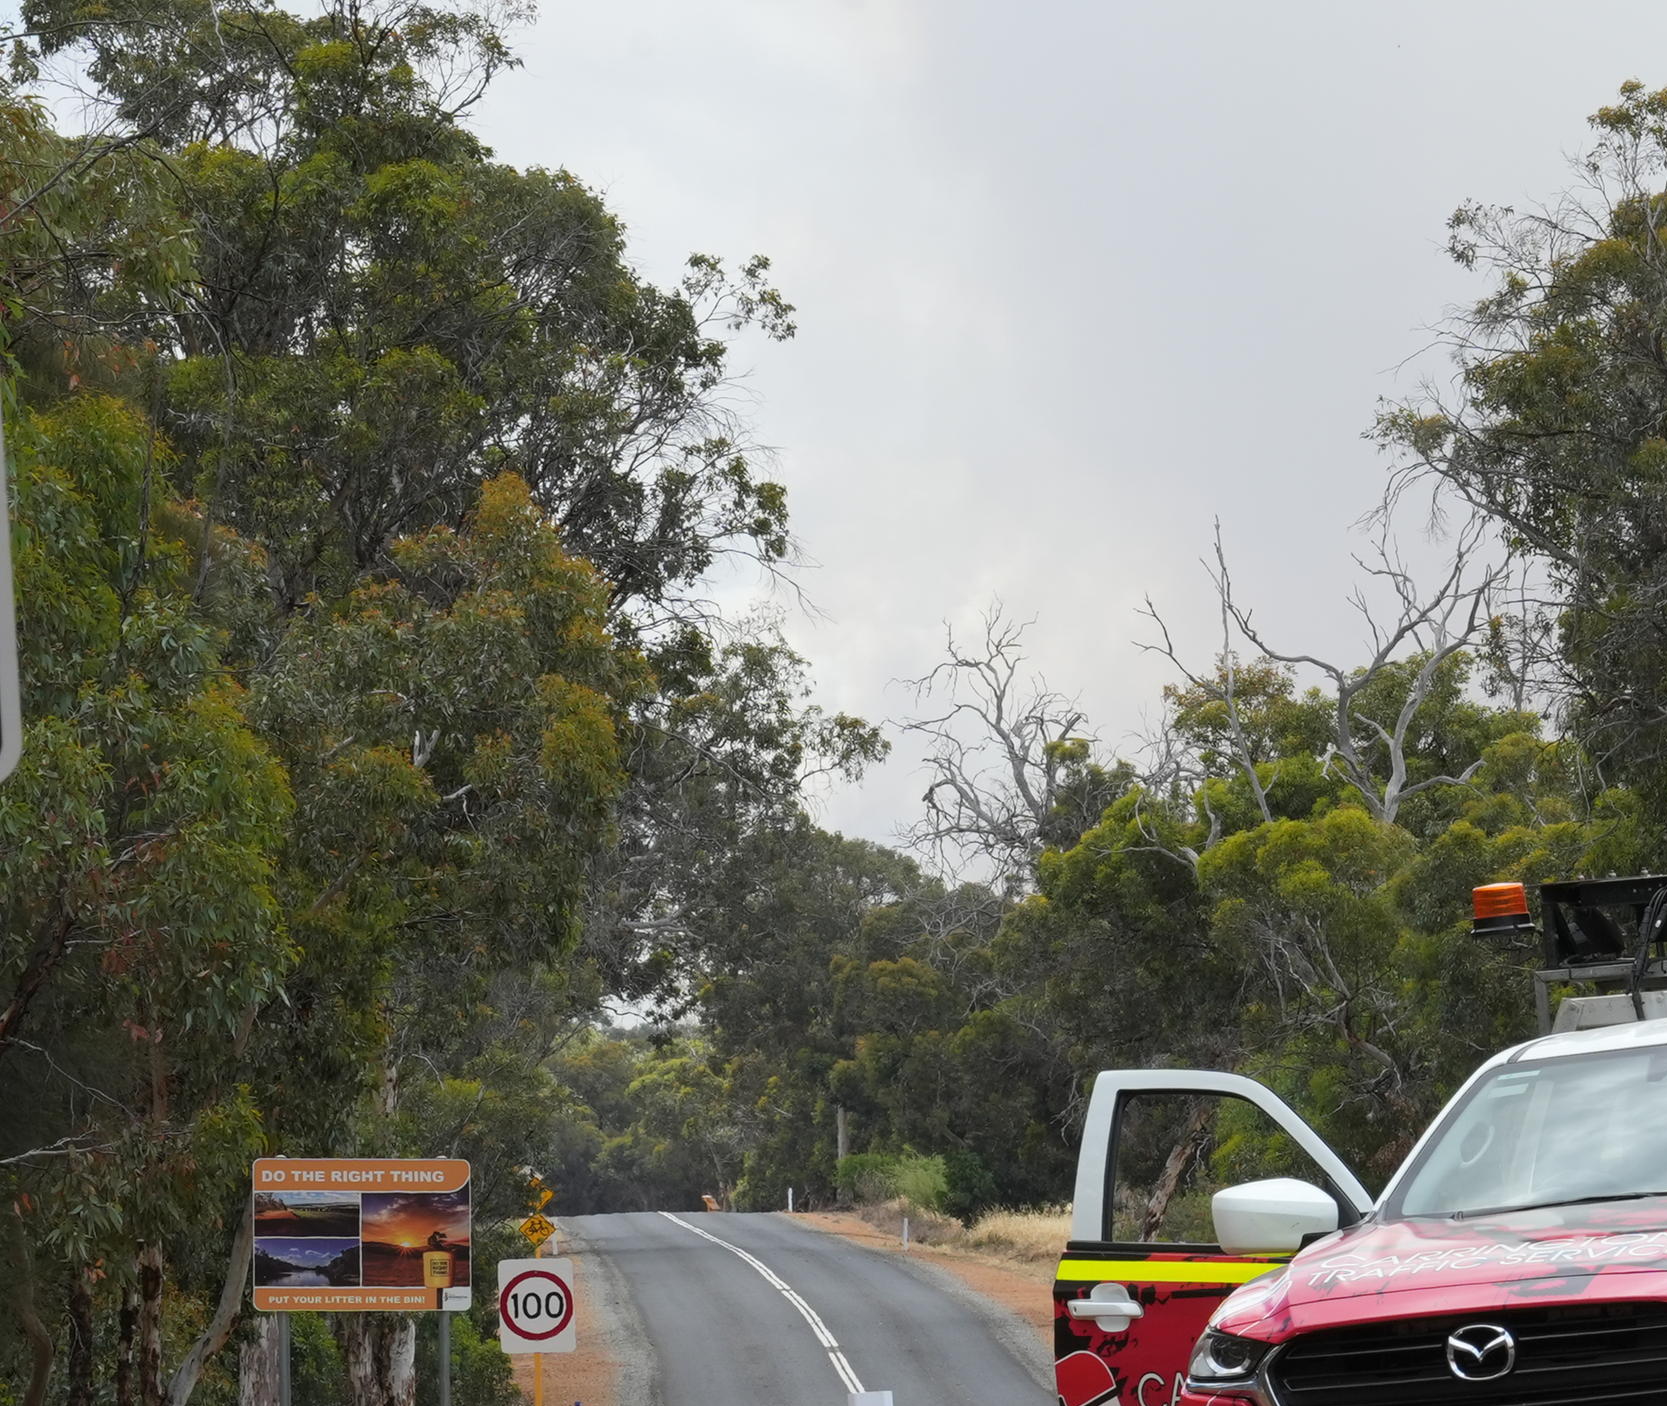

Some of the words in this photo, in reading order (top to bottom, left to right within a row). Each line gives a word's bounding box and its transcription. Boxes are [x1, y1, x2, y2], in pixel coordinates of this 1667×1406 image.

[261, 1170, 286, 1182] DO
[291, 1170, 326, 1182] THE
[331, 1170, 385, 1182] RIGHT
[390, 1170, 445, 1182] THING
[1308, 1254, 1489, 1286] TRAFFIC
[268, 1295, 289, 1304] PUT
[291, 1295, 322, 1304] YOUR
[325, 1295, 362, 1304] LITTER
[365, 1295, 377, 1304] IN
[380, 1295, 401, 1304] THE
[511, 1291, 564, 1319] 100
